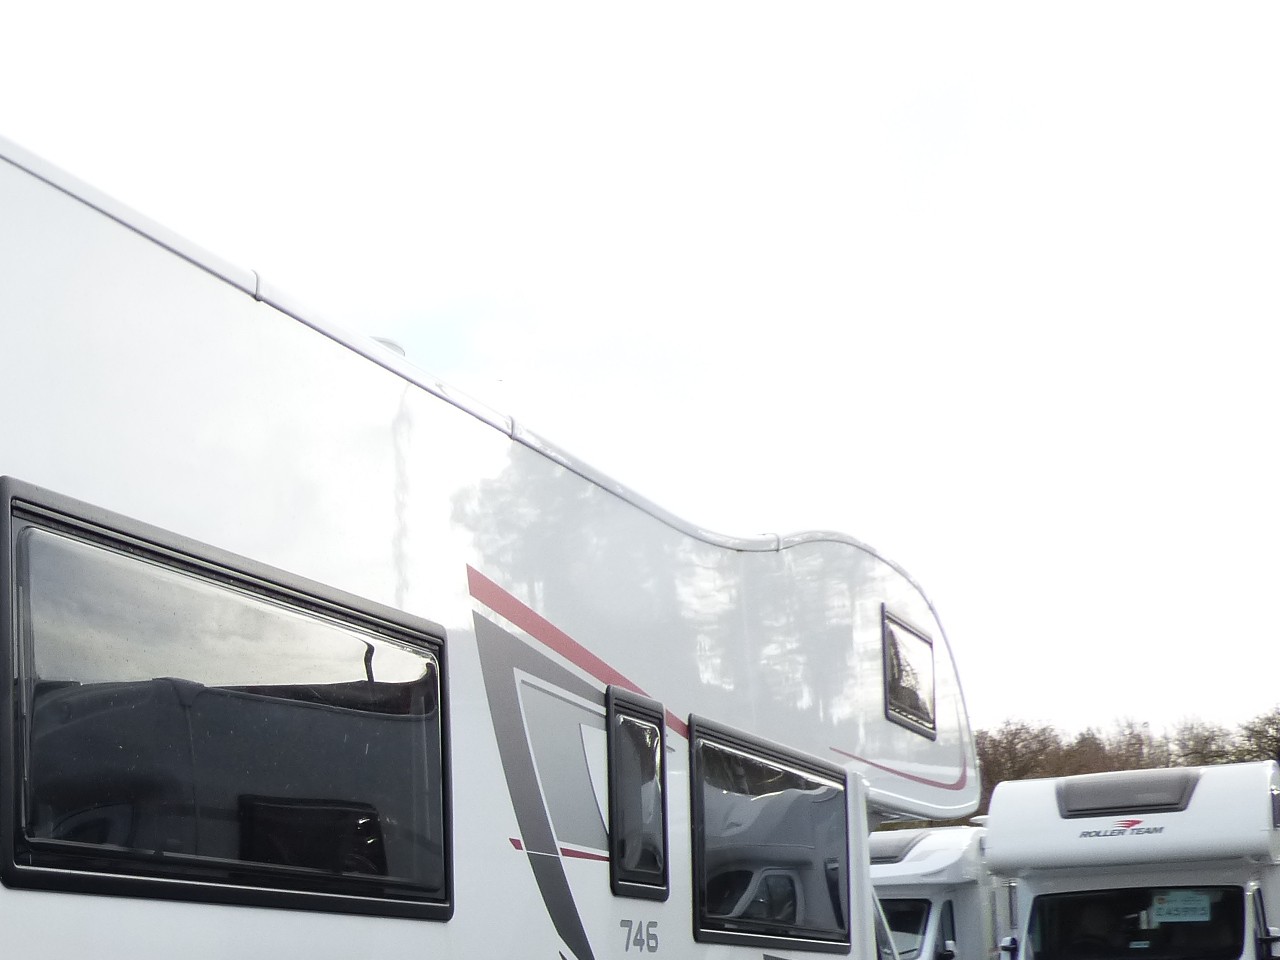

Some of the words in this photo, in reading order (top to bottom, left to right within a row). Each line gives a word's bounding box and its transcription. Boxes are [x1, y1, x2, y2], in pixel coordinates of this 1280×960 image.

[1079, 828, 1126, 839] ROLLER
[1129, 826, 1165, 836] TEAM
[619, 919, 659, 953] 746
